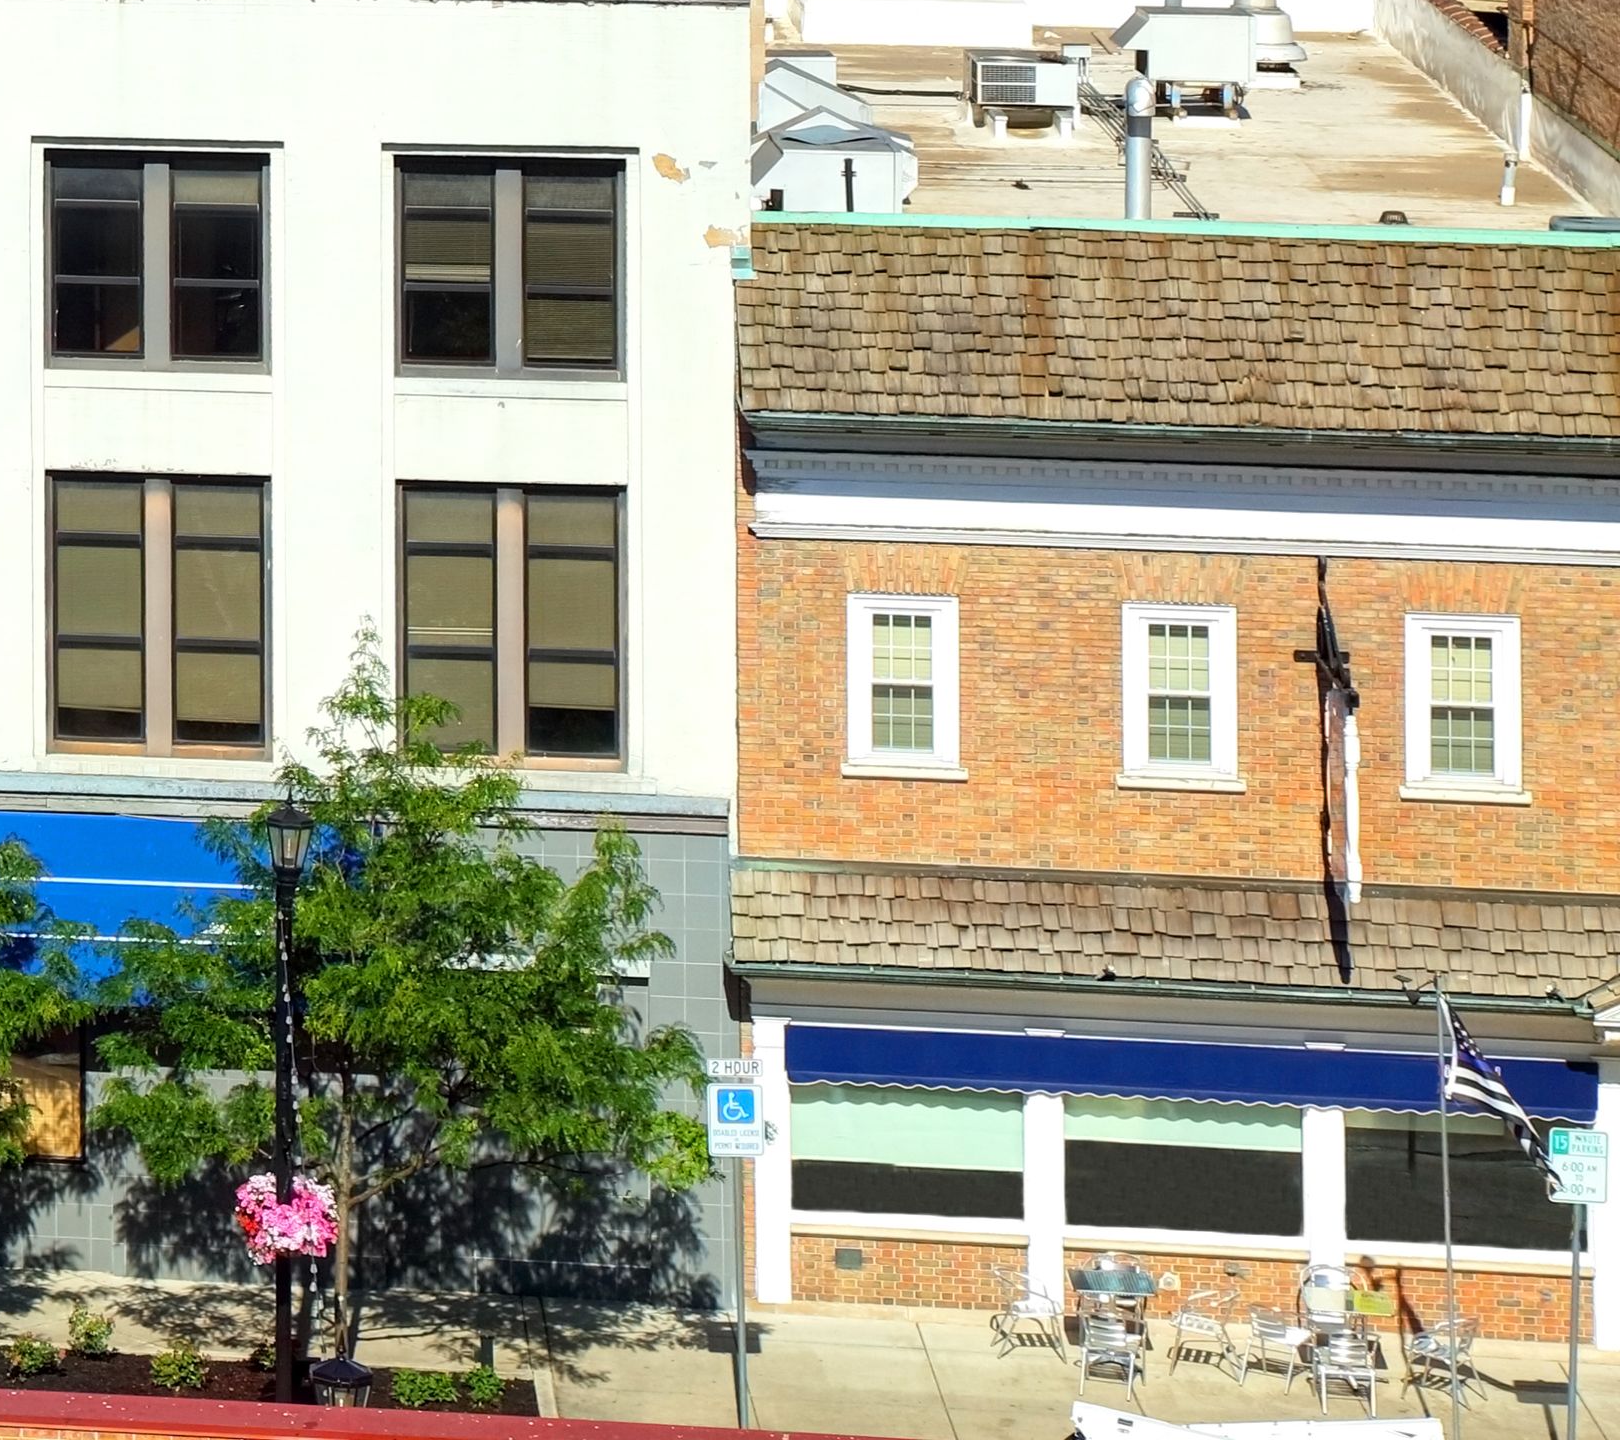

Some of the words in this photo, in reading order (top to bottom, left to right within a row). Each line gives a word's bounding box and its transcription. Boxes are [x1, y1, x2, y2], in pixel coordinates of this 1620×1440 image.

[712, 1061, 719, 1074] 2
[725, 1061, 760, 1075] HOUR
[1554, 1135, 1568, 1150] 15
[1571, 1144, 1604, 1154] PARKING
